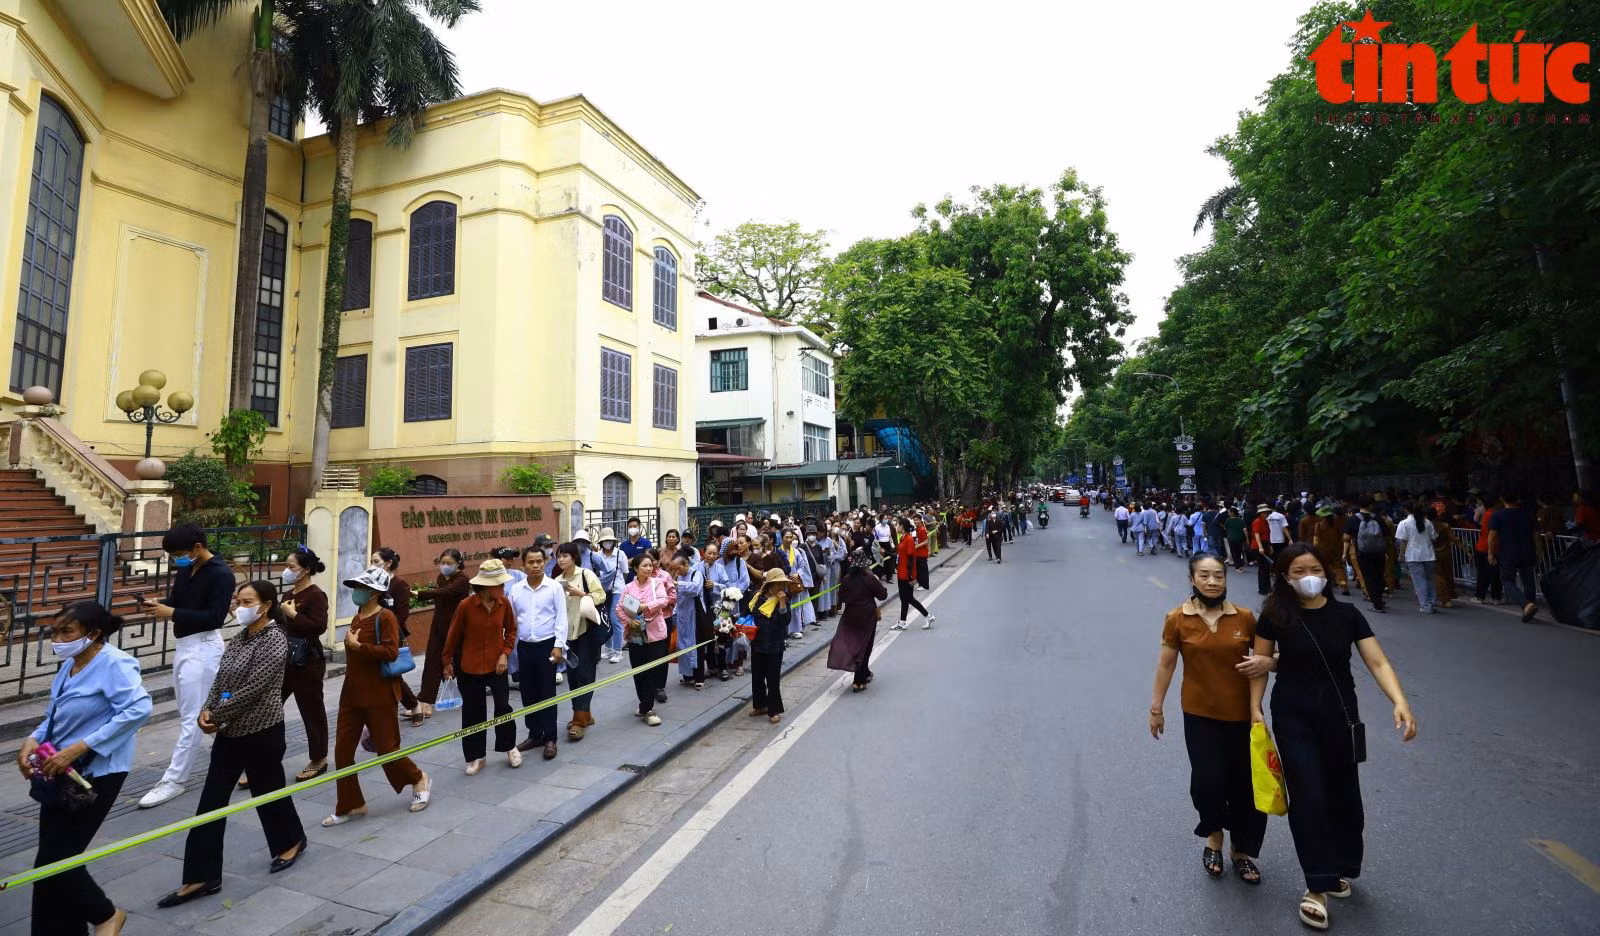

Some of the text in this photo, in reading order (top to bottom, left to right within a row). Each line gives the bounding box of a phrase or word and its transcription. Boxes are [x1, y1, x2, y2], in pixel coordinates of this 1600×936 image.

[401, 505, 425, 528] BẢO
[427, 506, 455, 527] TÀNG
[457, 505, 482, 525] CÔNG
[485, 508, 498, 524] AN
[500, 504, 524, 523] NHÂN
[428, 528, 529, 544] MUSEUM OF PUBLIC SECURITY
